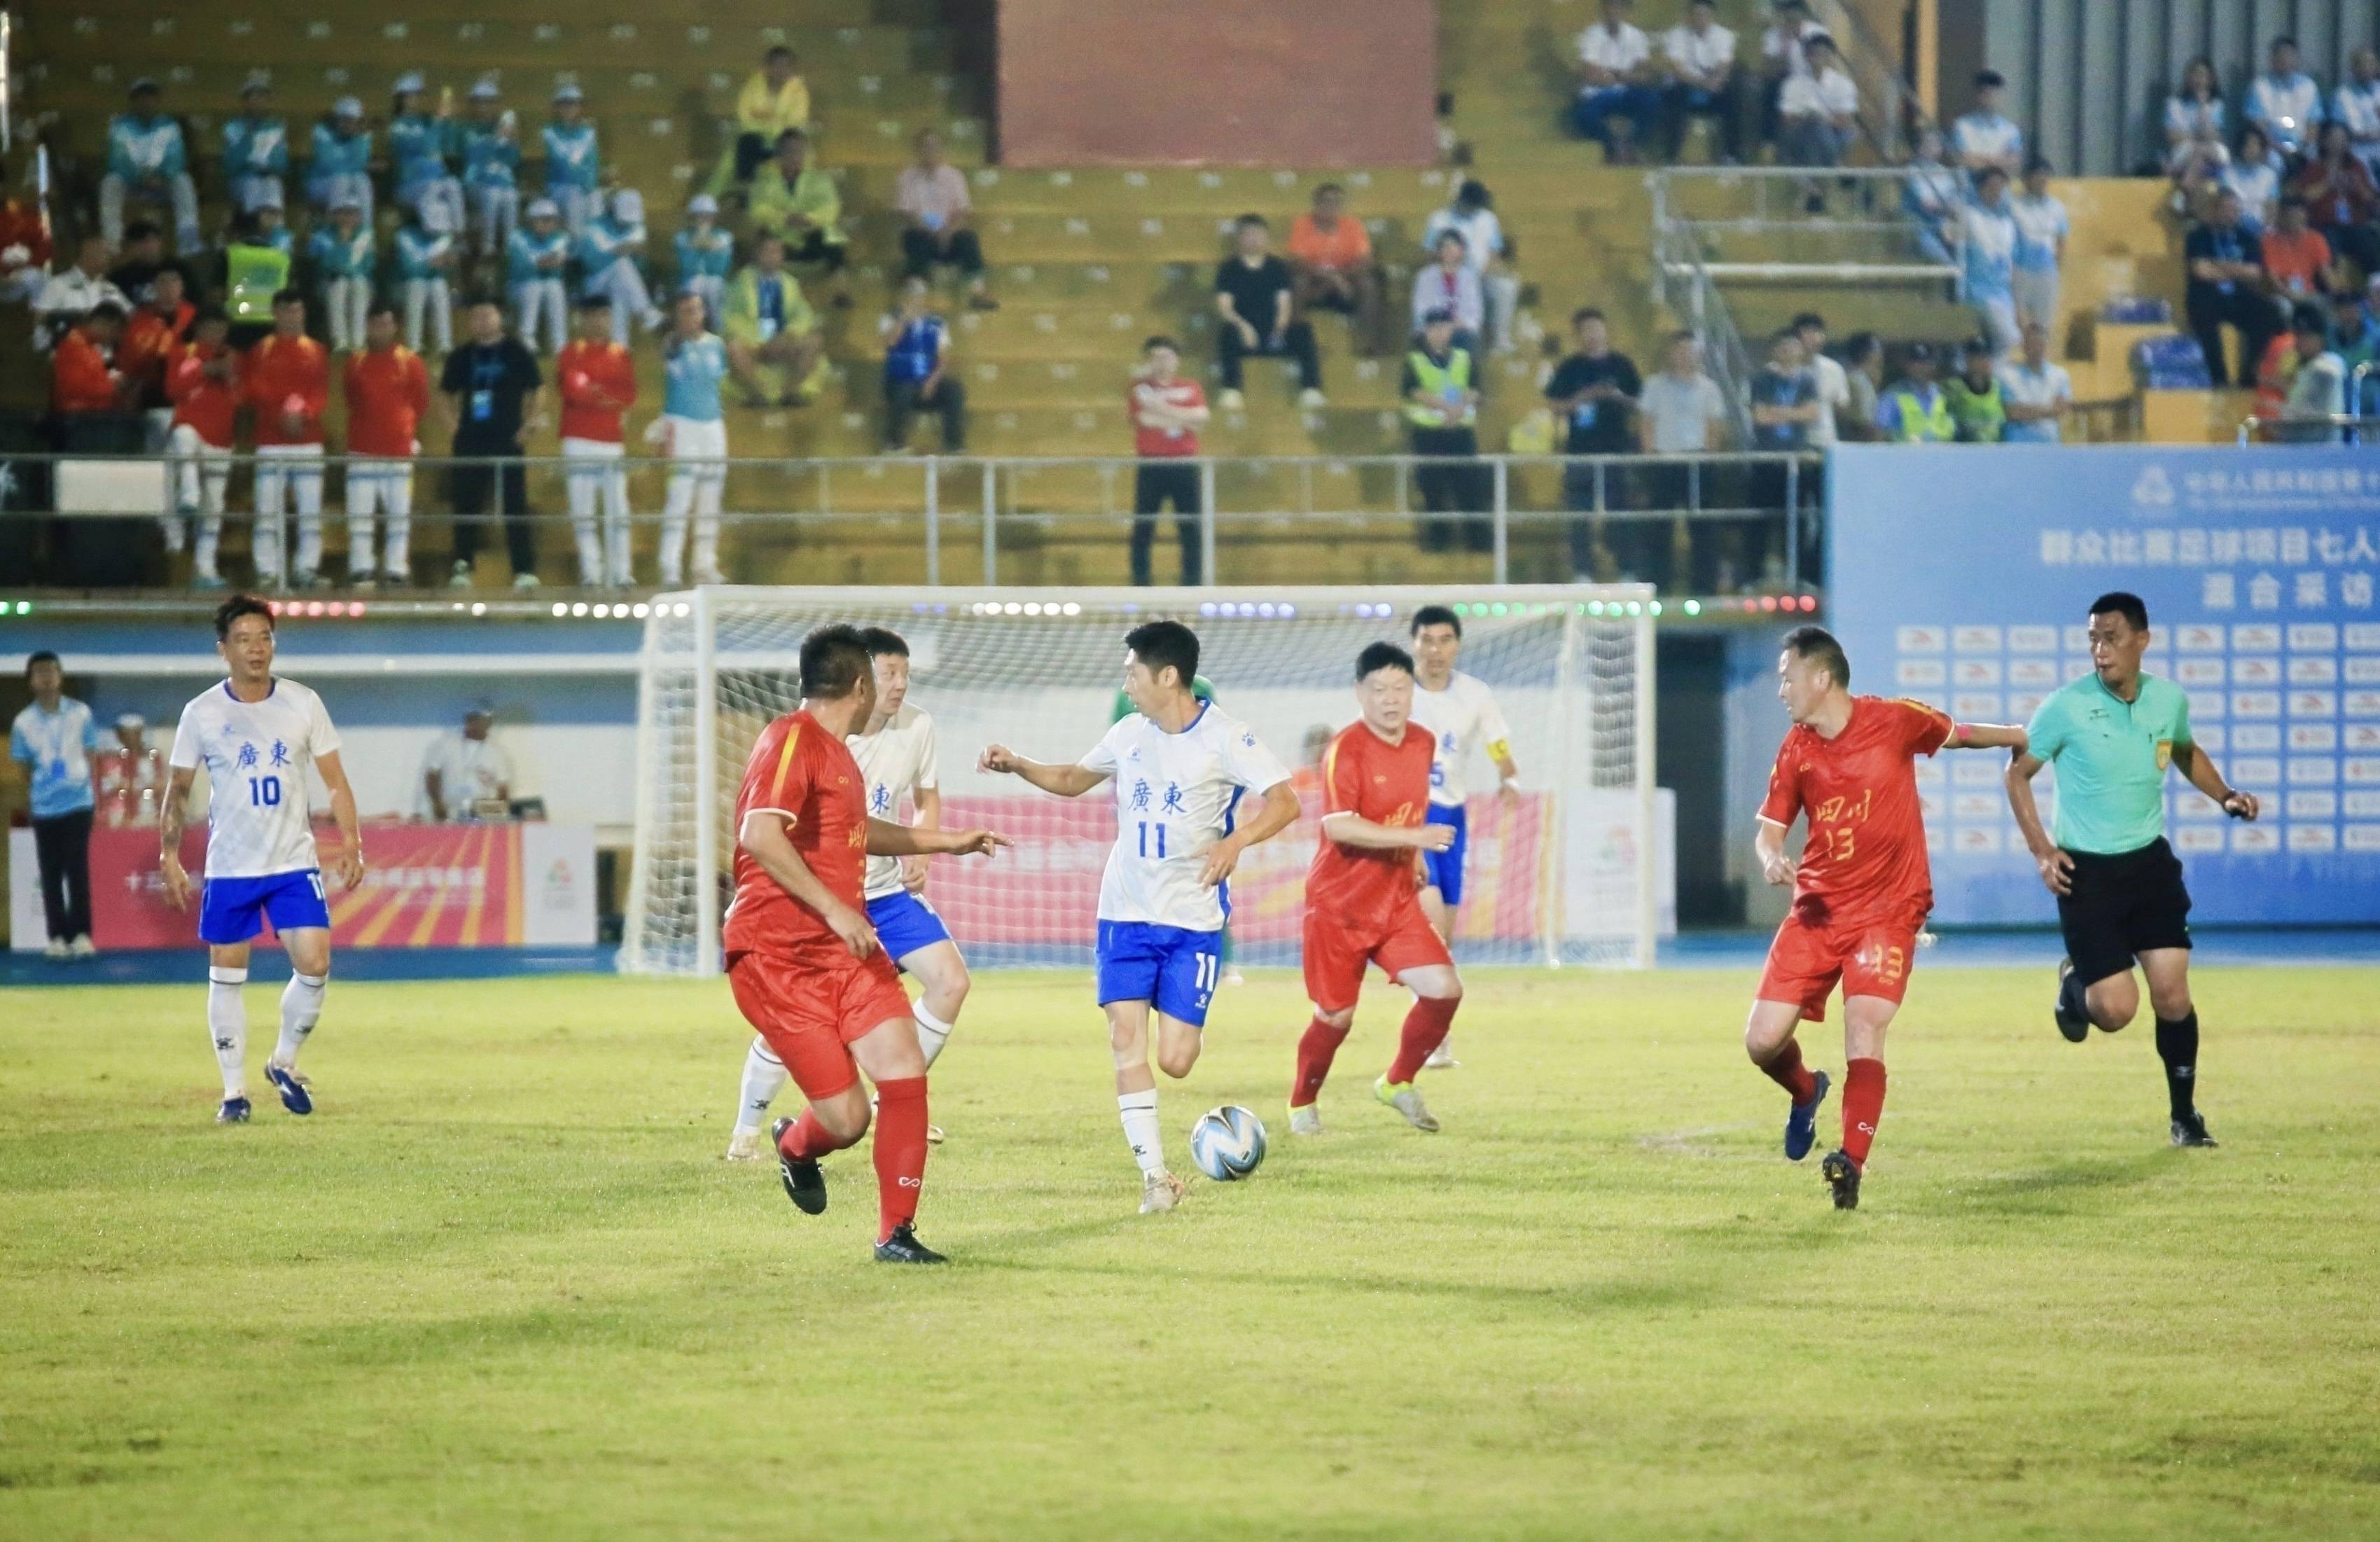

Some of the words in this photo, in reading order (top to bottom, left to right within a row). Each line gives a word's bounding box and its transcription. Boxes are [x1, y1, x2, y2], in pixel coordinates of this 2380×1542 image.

[235, 738, 291, 769] 廣東
[249, 776, 281, 806] 10
[1128, 778, 1187, 814] 廣東
[1816, 789, 1872, 822] 四川
[1138, 821, 1166, 859] 11
[1825, 828, 1855, 861] 13
[1195, 952, 1216, 992] 11
[1874, 943, 1903, 978] 13
